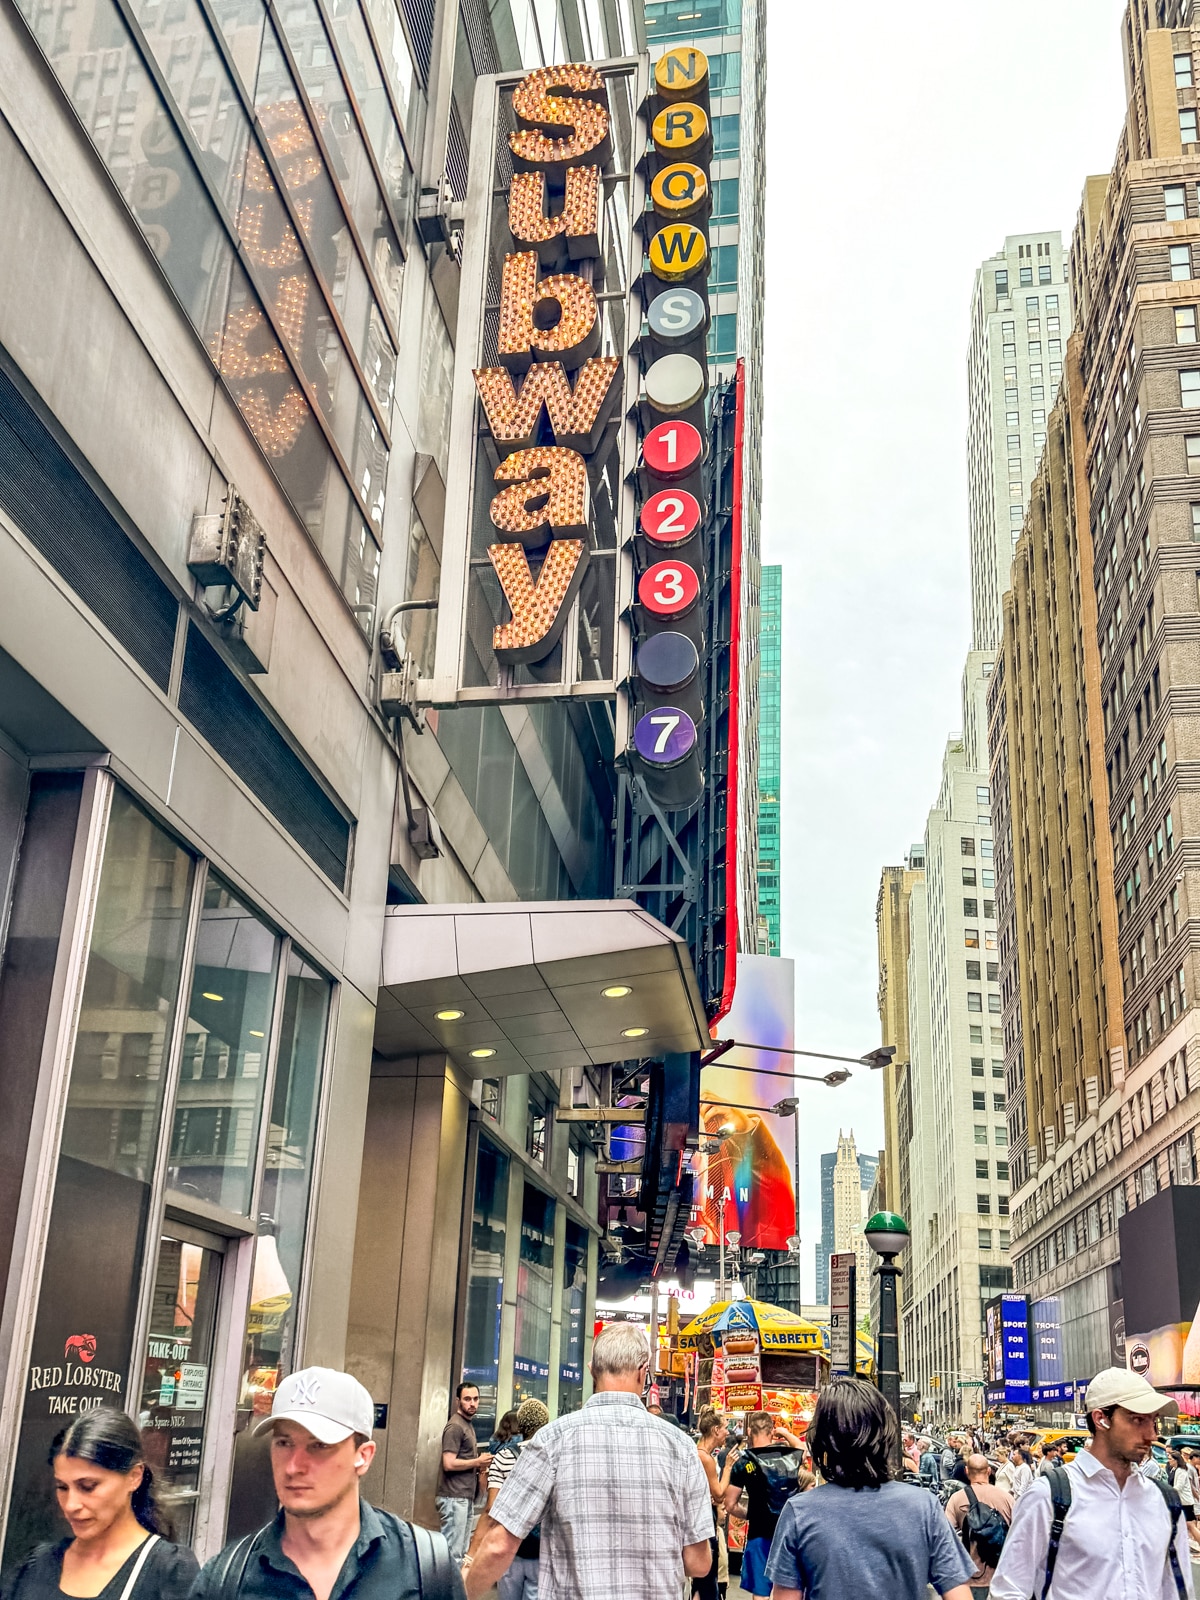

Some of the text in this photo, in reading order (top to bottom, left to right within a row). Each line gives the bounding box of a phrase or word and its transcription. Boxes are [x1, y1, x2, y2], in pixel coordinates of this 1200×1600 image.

[665, 53, 696, 84] N
[665, 110, 693, 141] R
[661, 170, 696, 201] Q
[658, 232, 697, 264] W
[659, 299, 693, 330] S
[472, 63, 621, 650] Subway
[658, 429, 677, 463] 1
[656, 497, 685, 534] 2
[653, 568, 685, 605] 3
[650, 715, 680, 753] 7
[764, 1333, 817, 1344] SABRETT
[1003, 1321, 1027, 1329] SPORT
[149, 1341, 191, 1360] TAKE-OUT
[30, 1363, 121, 1393] RED LOBSTER
[48, 1396, 103, 1414] TAKE OUT
